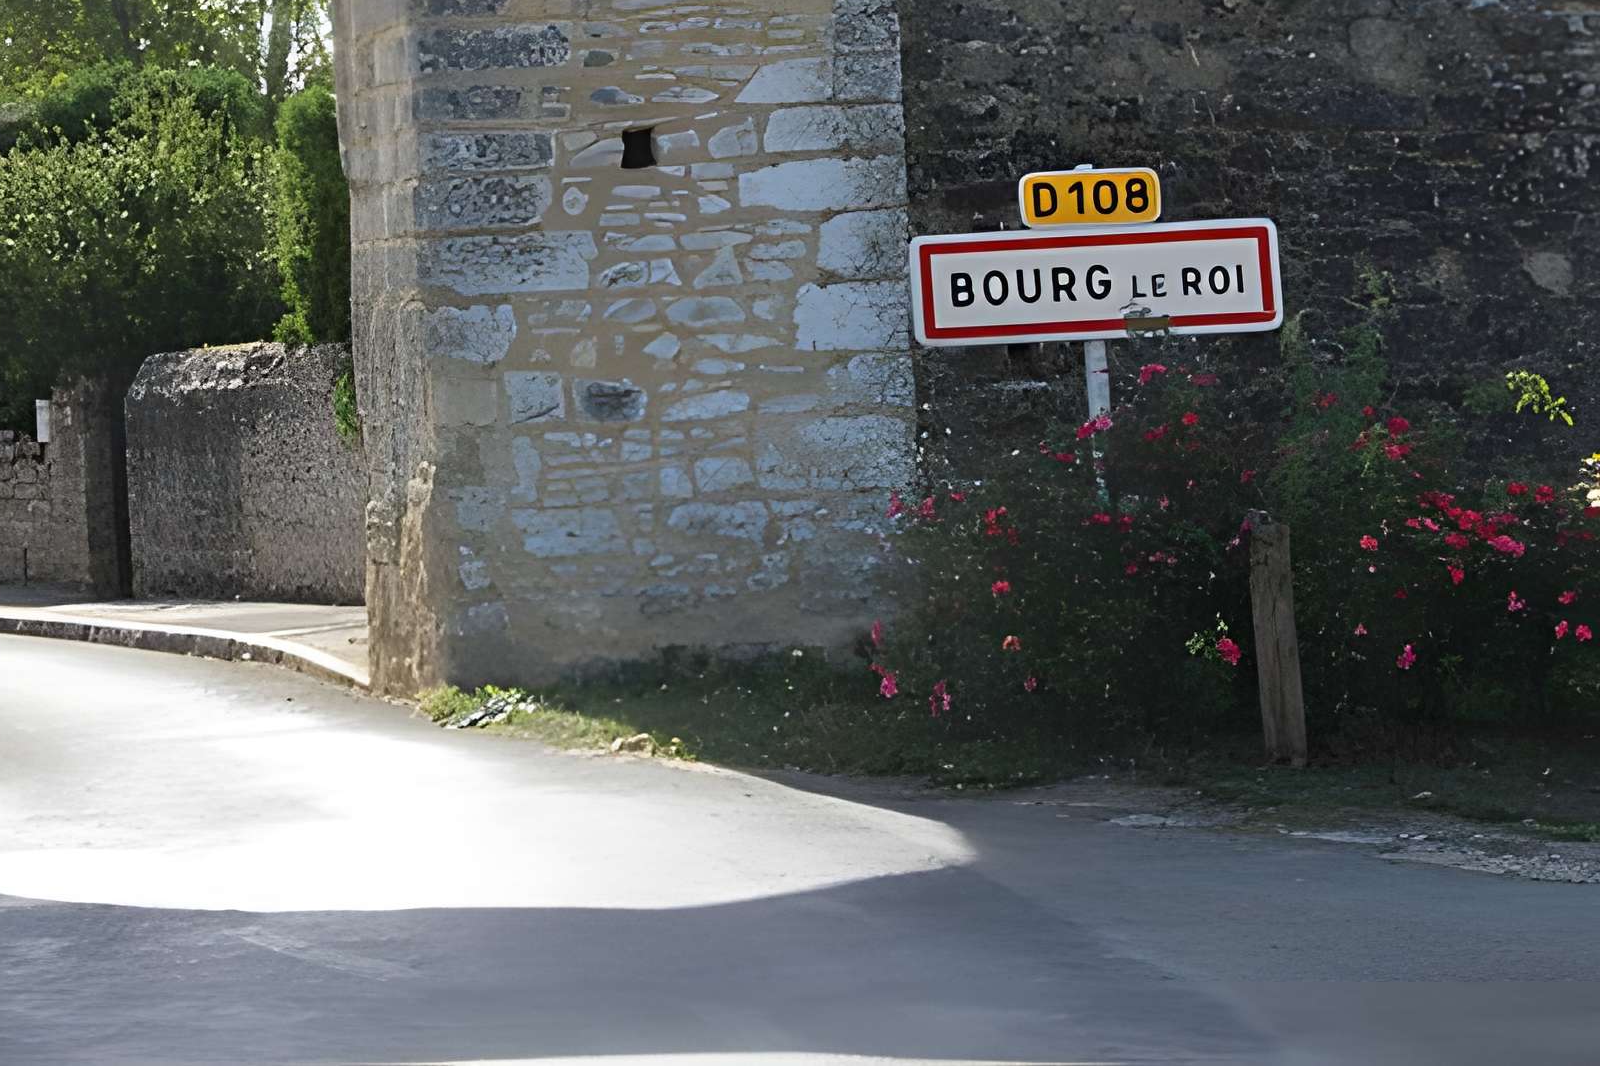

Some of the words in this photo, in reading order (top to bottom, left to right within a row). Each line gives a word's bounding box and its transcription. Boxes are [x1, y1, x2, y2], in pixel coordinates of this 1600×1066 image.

[950, 264, 1113, 308] BOURG
[1132, 273, 1167, 298] LE
[1181, 264, 1245, 295] ROI
